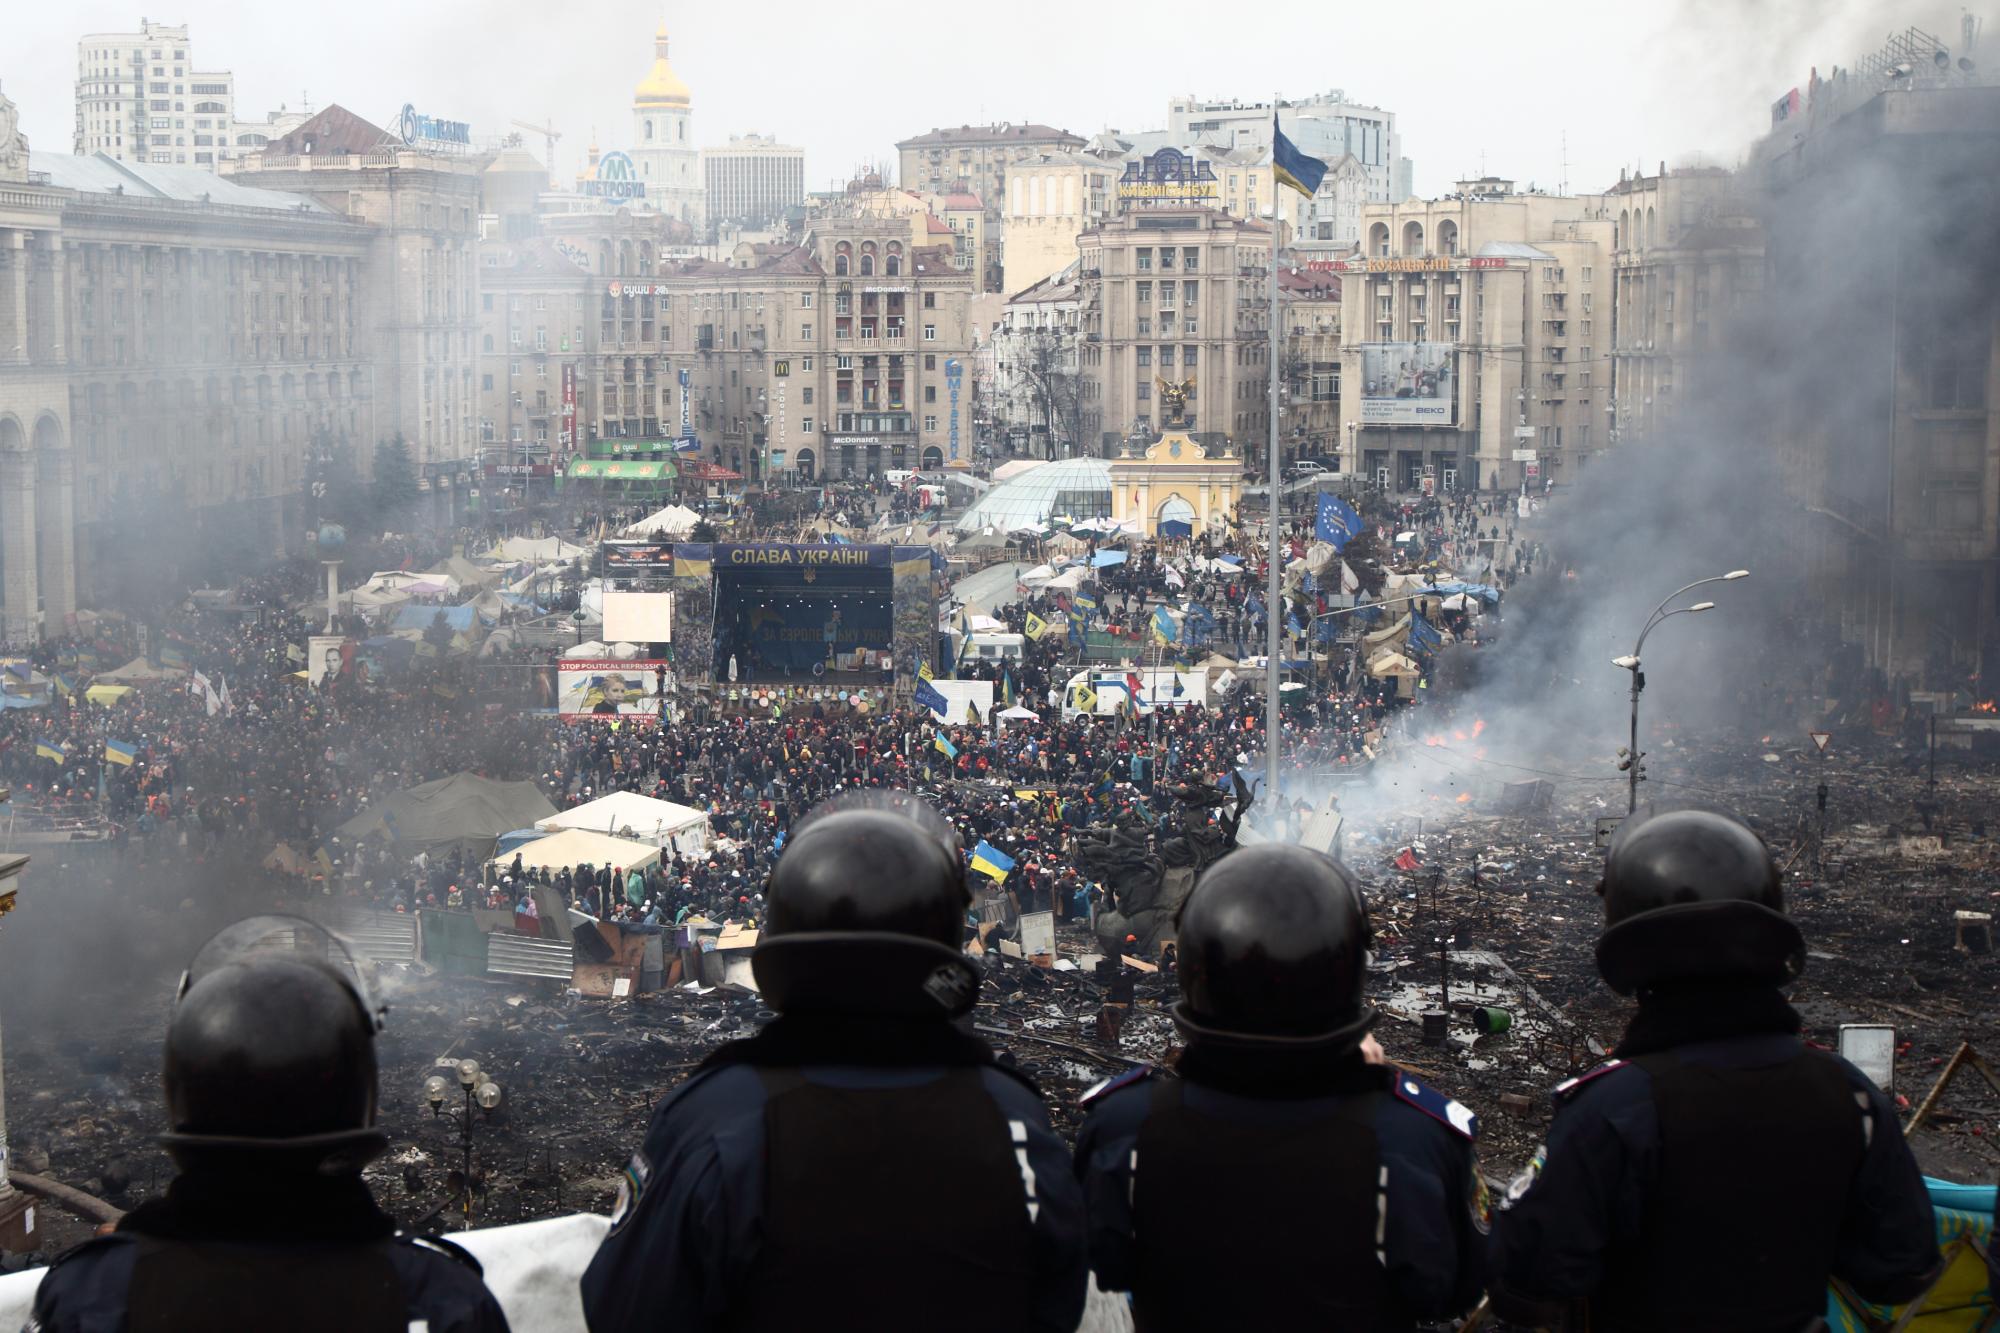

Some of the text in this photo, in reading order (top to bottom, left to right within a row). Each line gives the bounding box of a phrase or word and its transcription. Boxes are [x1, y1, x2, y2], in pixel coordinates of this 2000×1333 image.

[586, 181, 645, 198] МЕТРОБУД
[833, 436, 879, 444] McDonald's
[731, 548, 869, 564] СЛАВА УКРАЇНІ!
